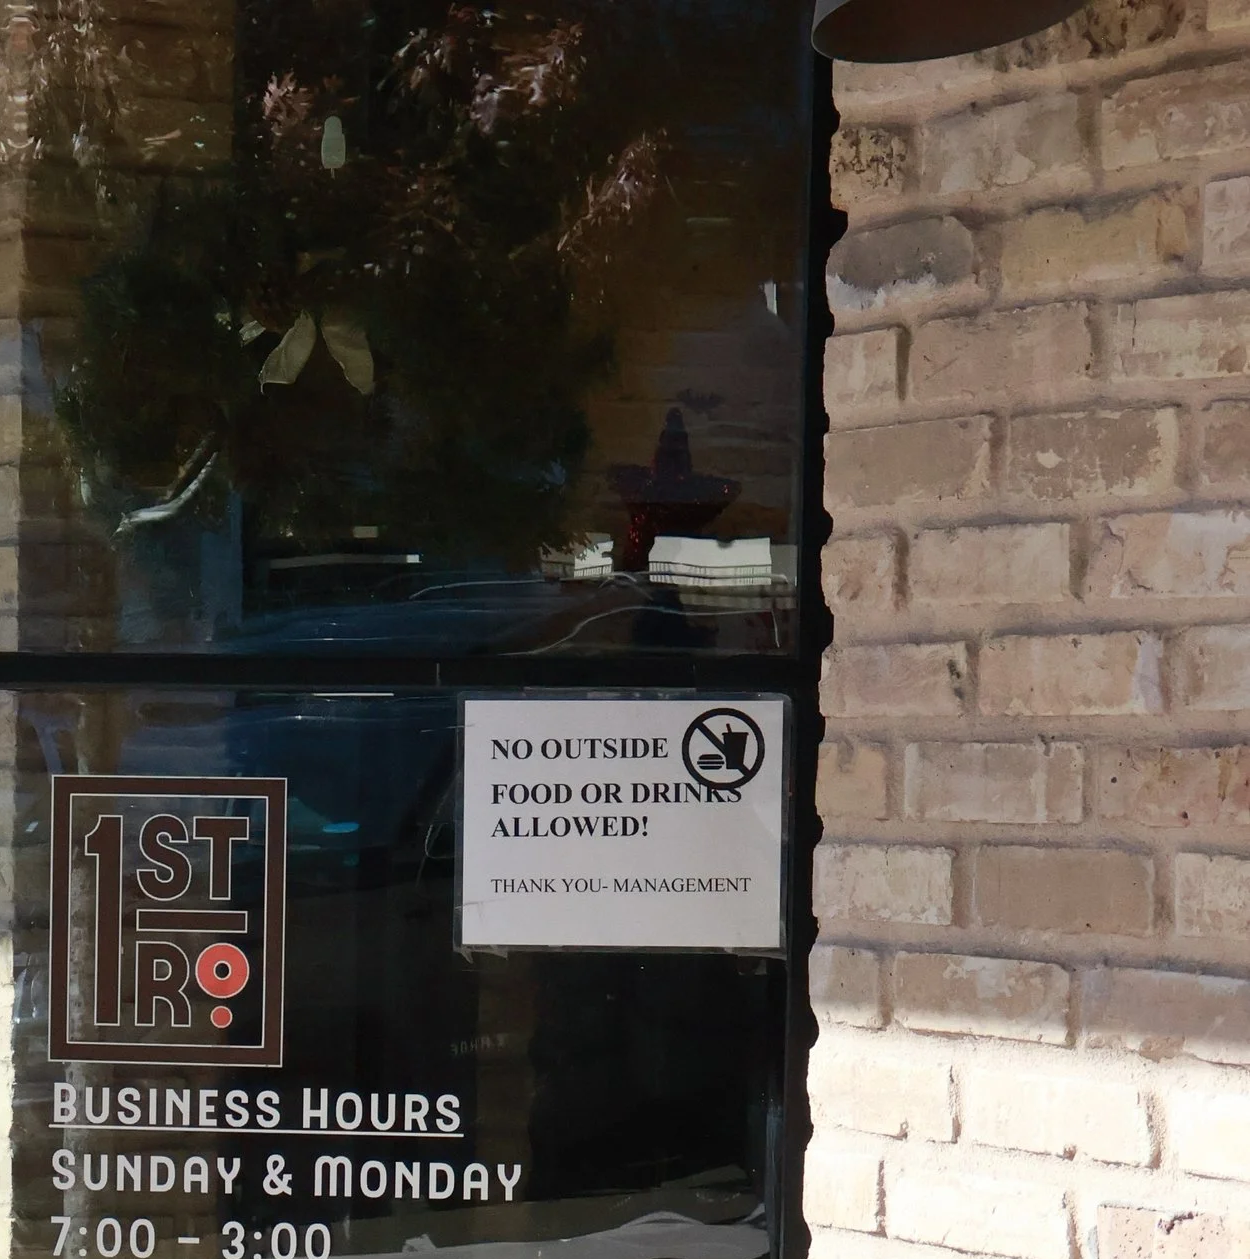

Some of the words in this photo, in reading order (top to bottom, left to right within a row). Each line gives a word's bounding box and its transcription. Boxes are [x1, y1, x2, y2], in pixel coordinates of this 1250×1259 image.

[491, 738, 533, 760] NO
[541, 737, 669, 760] OUTSIDE
[491, 783, 573, 805] FOOD
[581, 783, 623, 804] OR
[632, 782, 743, 804] DRINKS
[491, 815, 649, 838] ALLOWED!
[491, 878, 557, 893] THANK
[562, 878, 608, 893] YOU-
[613, 877, 752, 893] MANAGEMENT
[52, 1082, 281, 1128] BUSINESS
[302, 1087, 461, 1132] HOURS
[52, 1149, 241, 1194] SUNDAY
[263, 1154, 293, 1196] &
[314, 1155, 522, 1201] MONDAY
[51, 1216, 155, 1258] 7:00
